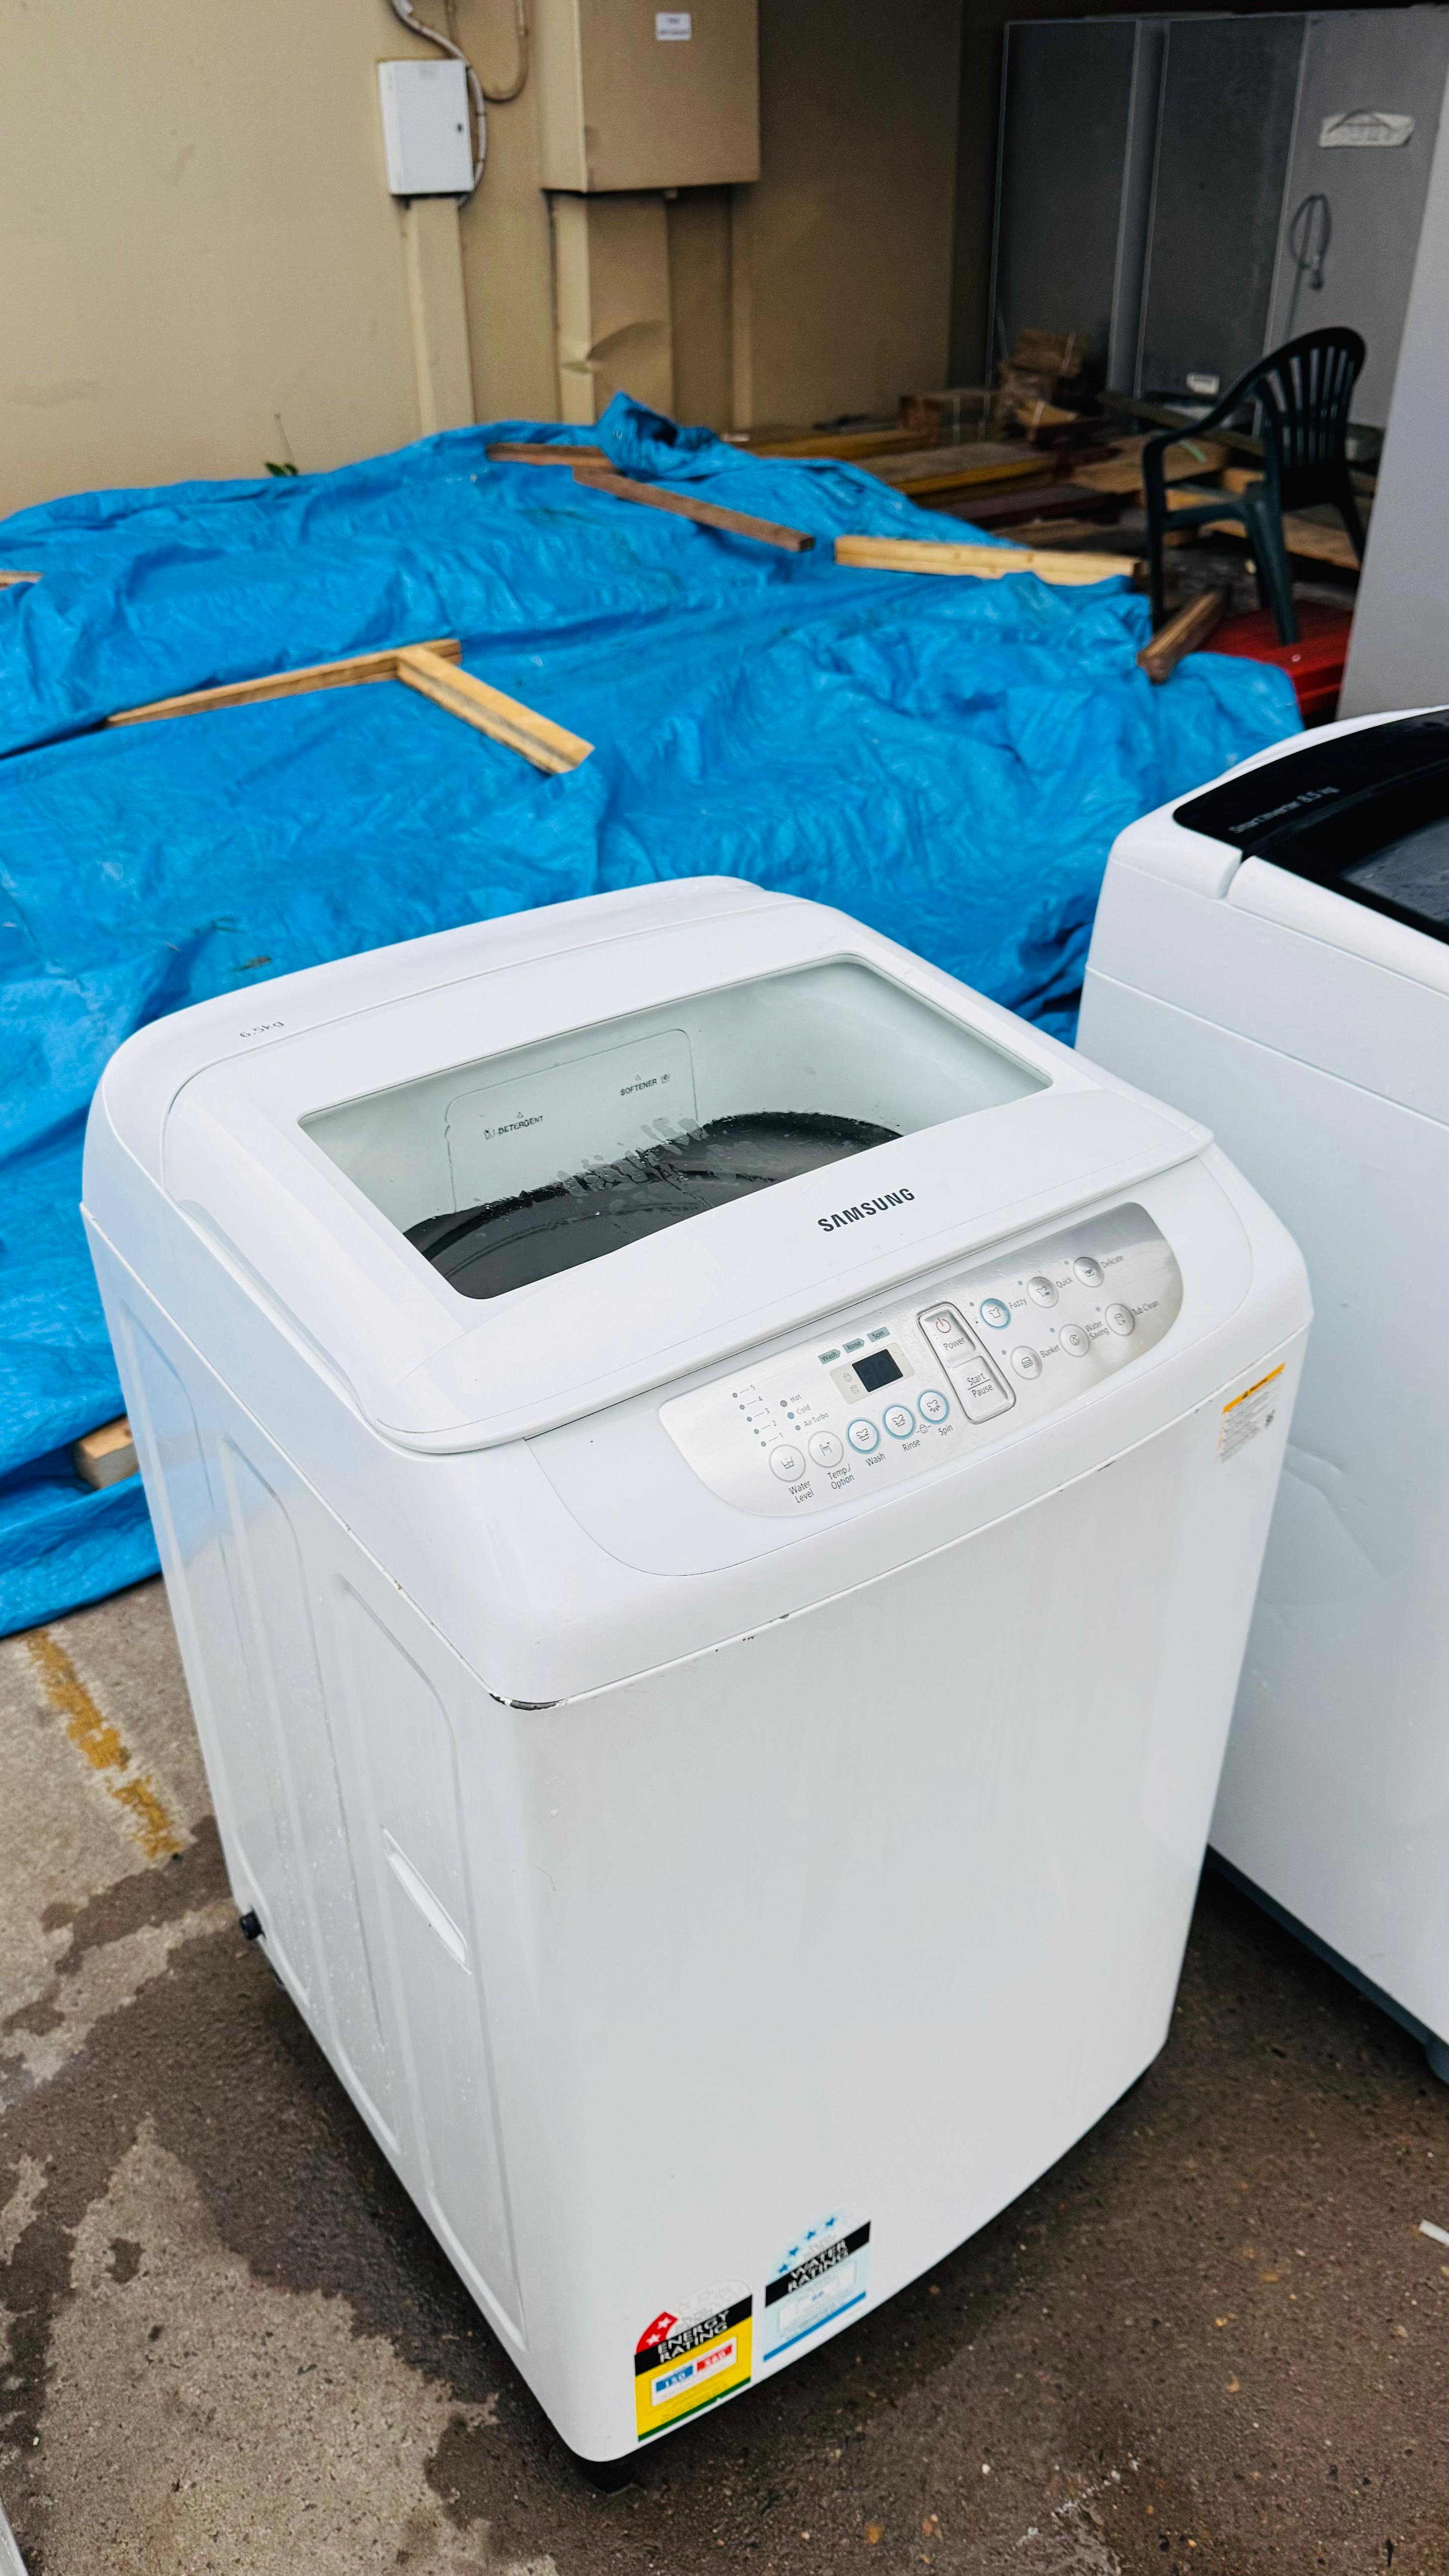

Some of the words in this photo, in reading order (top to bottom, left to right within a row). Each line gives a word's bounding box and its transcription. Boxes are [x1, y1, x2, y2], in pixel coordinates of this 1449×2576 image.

[239, 1021, 285, 1038] 6.5kg
[620, 1078, 658, 1096] SOFTENER
[498, 1115, 544, 1135] DETERGENT
[817, 1188, 915, 1232] SAMSUNG
[1100, 1255, 1125, 1268] Delicate
[1055, 1276, 1074, 1288] Quick
[1008, 1298, 1027, 1309] Fuzzy
[1084, 1321, 1103, 1332] Water
[1088, 1328, 1110, 1340] Saving
[821, 1351, 838, 1361] Wash
[846, 1341, 862, 1351] Rinse
[872, 1331, 885, 1339] Spin
[943, 1337, 965, 1351] Power
[1039, 1344, 1061, 1358] Blanket
[967, 1373, 986, 1386] Start
[972, 1384, 993, 1398] Pause
[790, 1394, 801, 1403] Hot
[796, 1404, 811, 1415] Cold
[812, 1412, 829, 1423] Turbo
[938, 1424, 953, 1436] Spin
[902, 1438, 921, 1452] Rinse
[865, 1453, 886, 1467] Wash
[788, 1480, 811, 1495] Water
[831, 1474, 855, 1490] Option
[795, 1489, 814, 1503] Level
[790, 2239, 847, 2279] WATER
[787, 2251, 849, 2293] RATING
[658, 2309, 730, 2354] ENERGY
[660, 2321, 728, 2364] RATING
